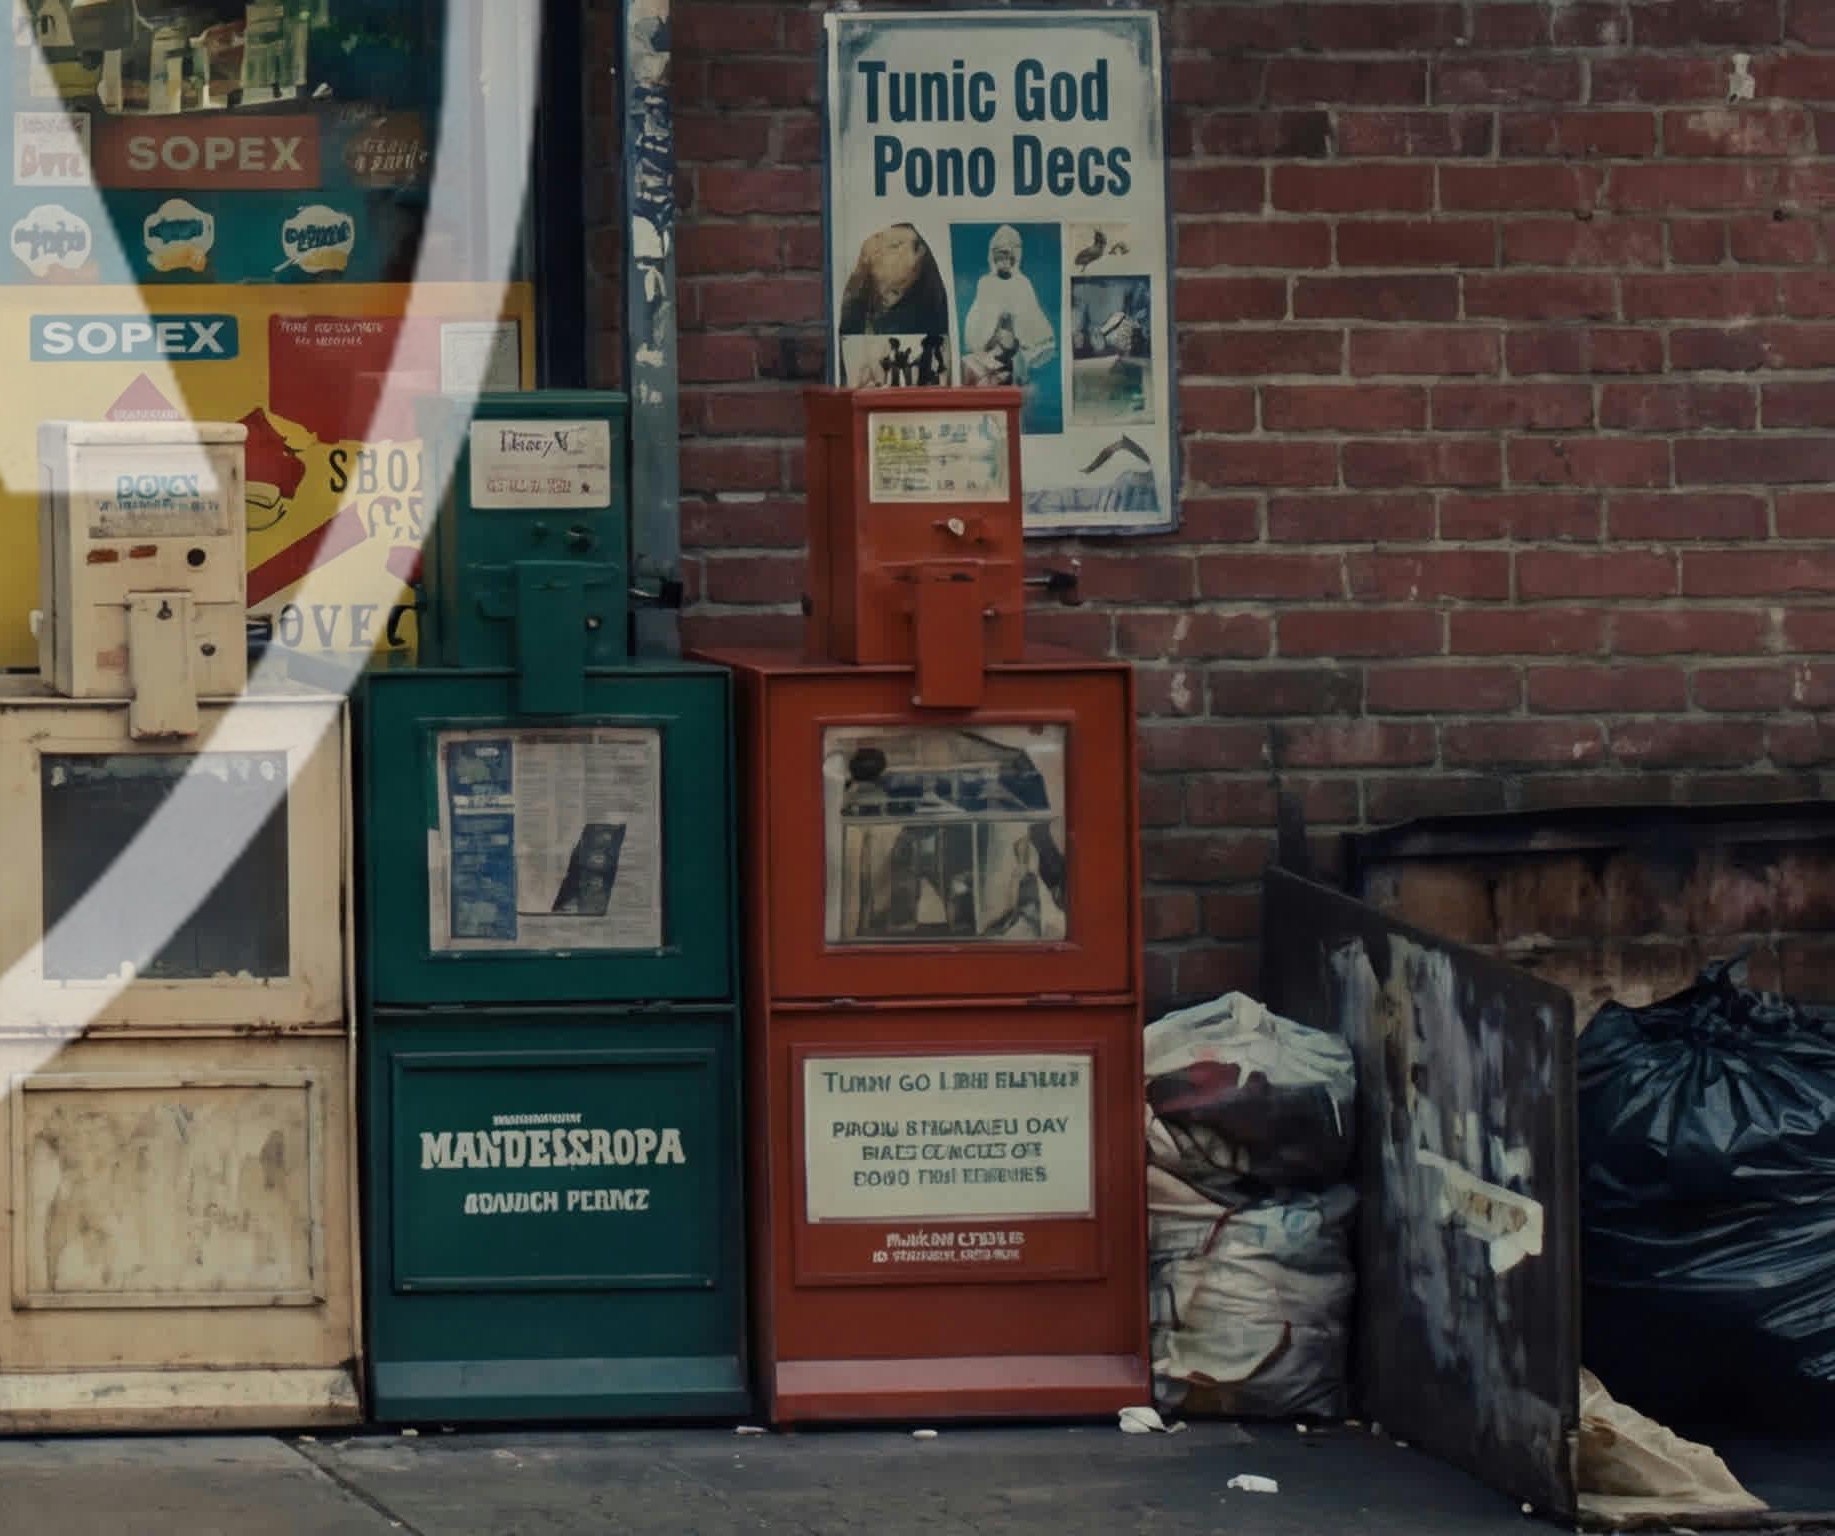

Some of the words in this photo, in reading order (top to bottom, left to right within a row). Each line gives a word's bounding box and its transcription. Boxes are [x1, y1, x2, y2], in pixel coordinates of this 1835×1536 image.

[858, 60, 996, 124] Tunic
[1013, 58, 1110, 123] God
[127, 135, 305, 172] SOPEX
[873, 135, 996, 198] Pono
[1012, 134, 1132, 198] Decs
[41, 320, 226, 355] SOPEX
